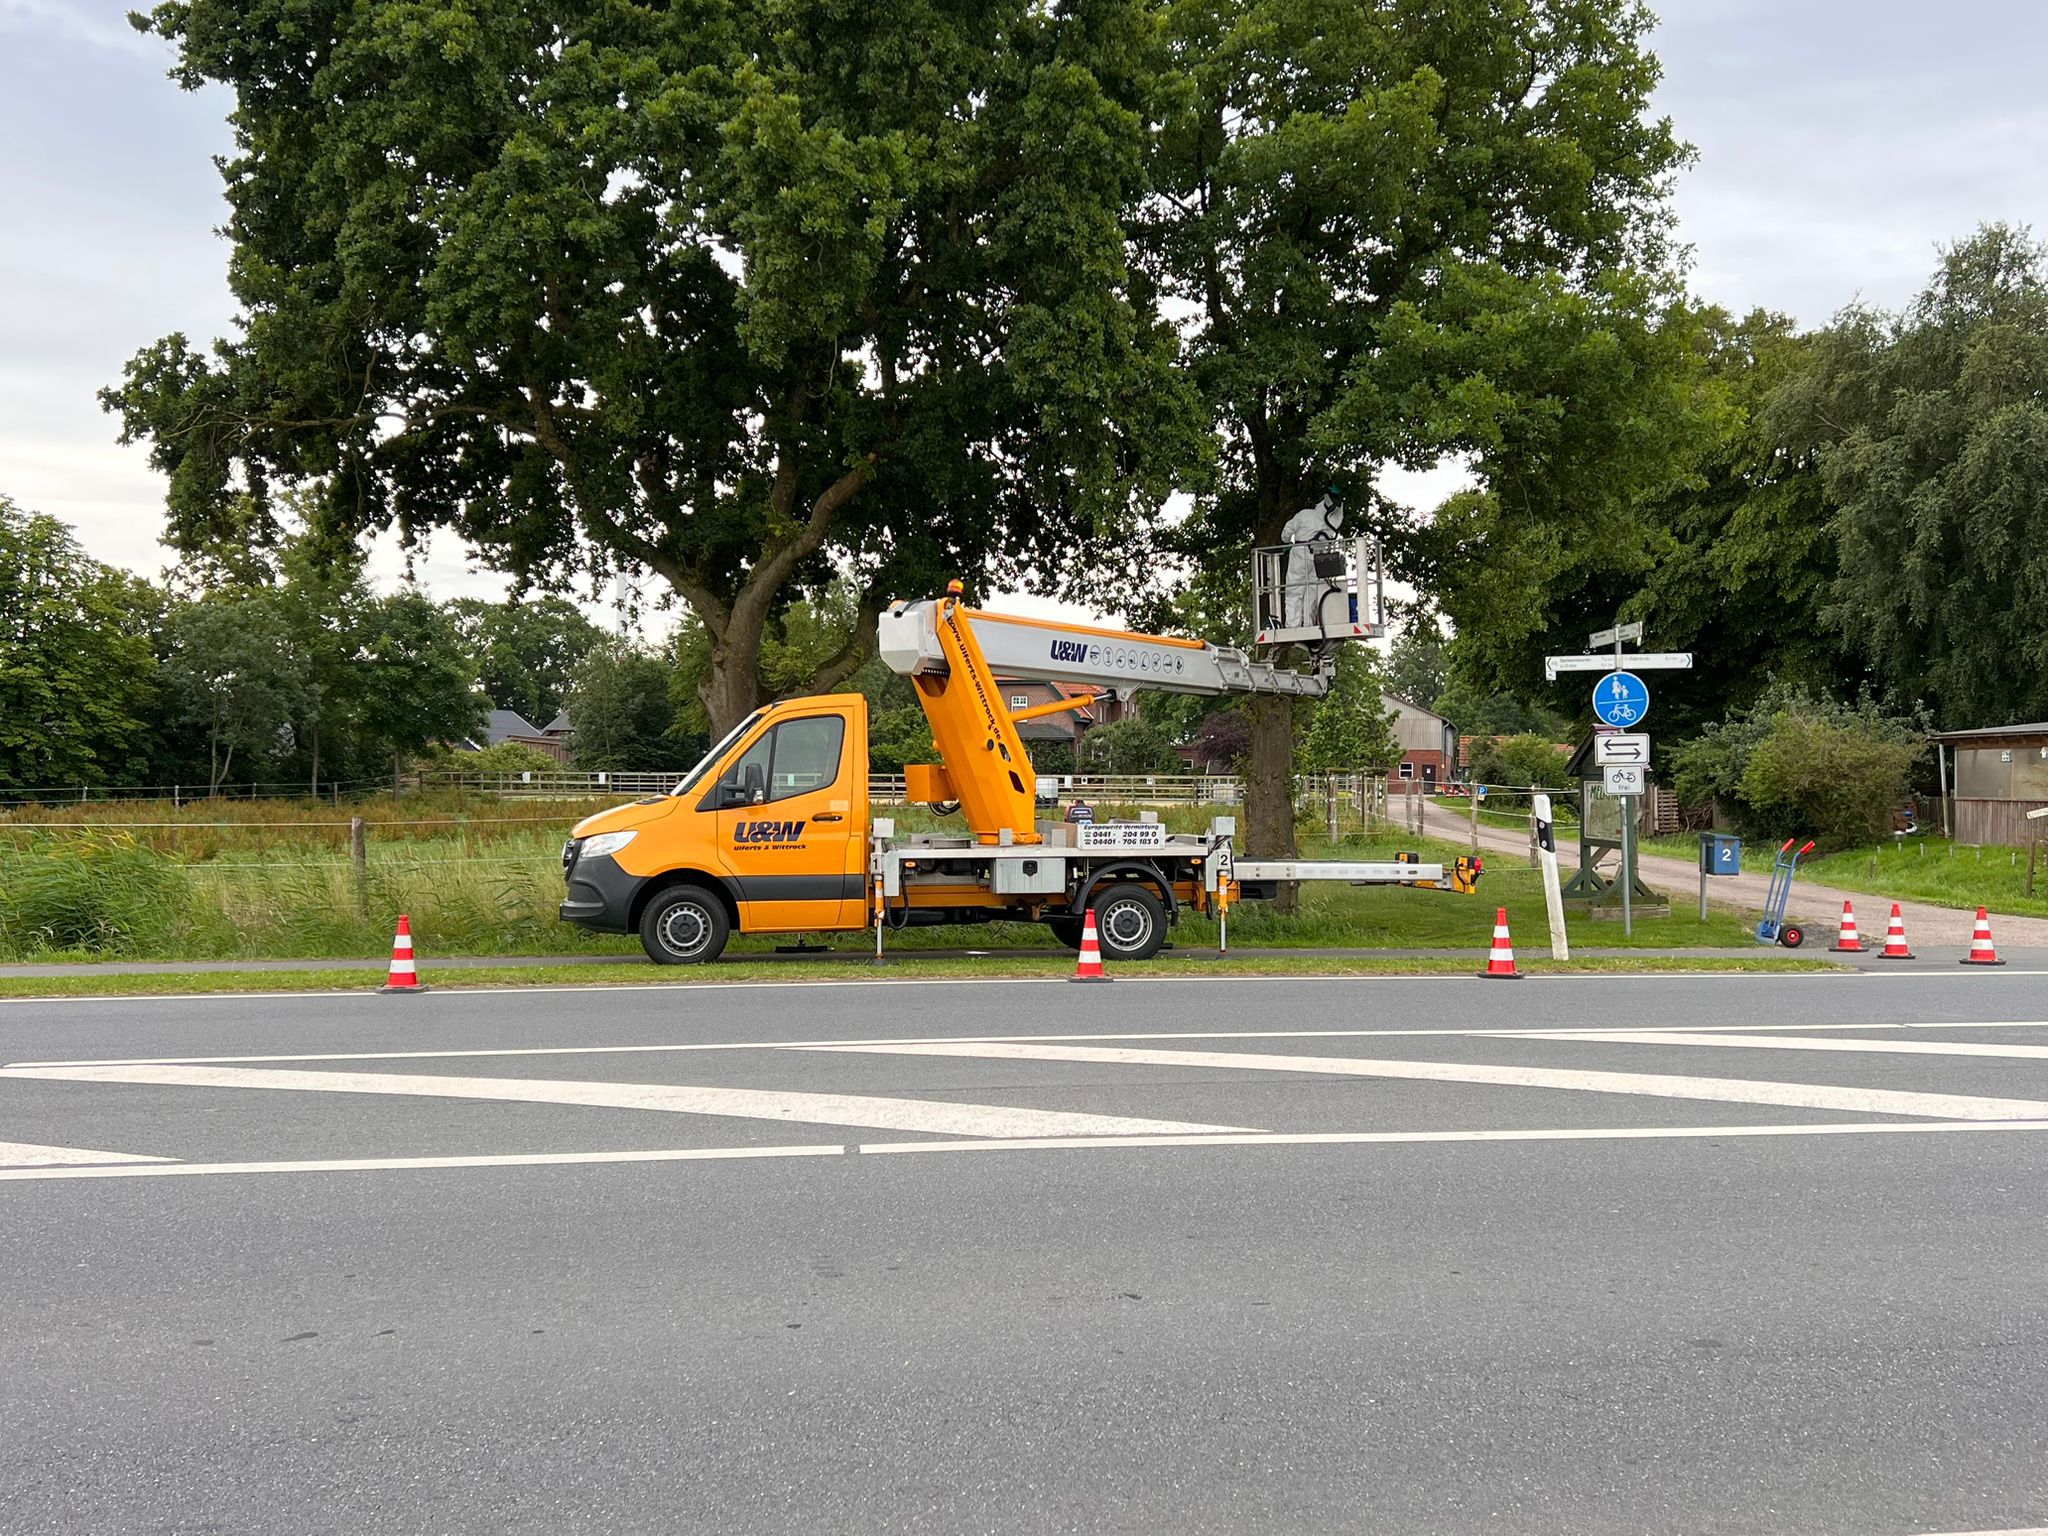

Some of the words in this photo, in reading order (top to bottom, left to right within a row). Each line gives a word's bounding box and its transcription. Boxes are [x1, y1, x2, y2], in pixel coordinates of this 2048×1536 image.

[1050, 639, 1088, 663] U&W
[734, 821, 807, 843] U&W
[1220, 854, 1228, 866] 2
[1722, 848, 1731, 862] 2
[873, 858, 878, 870] 1
